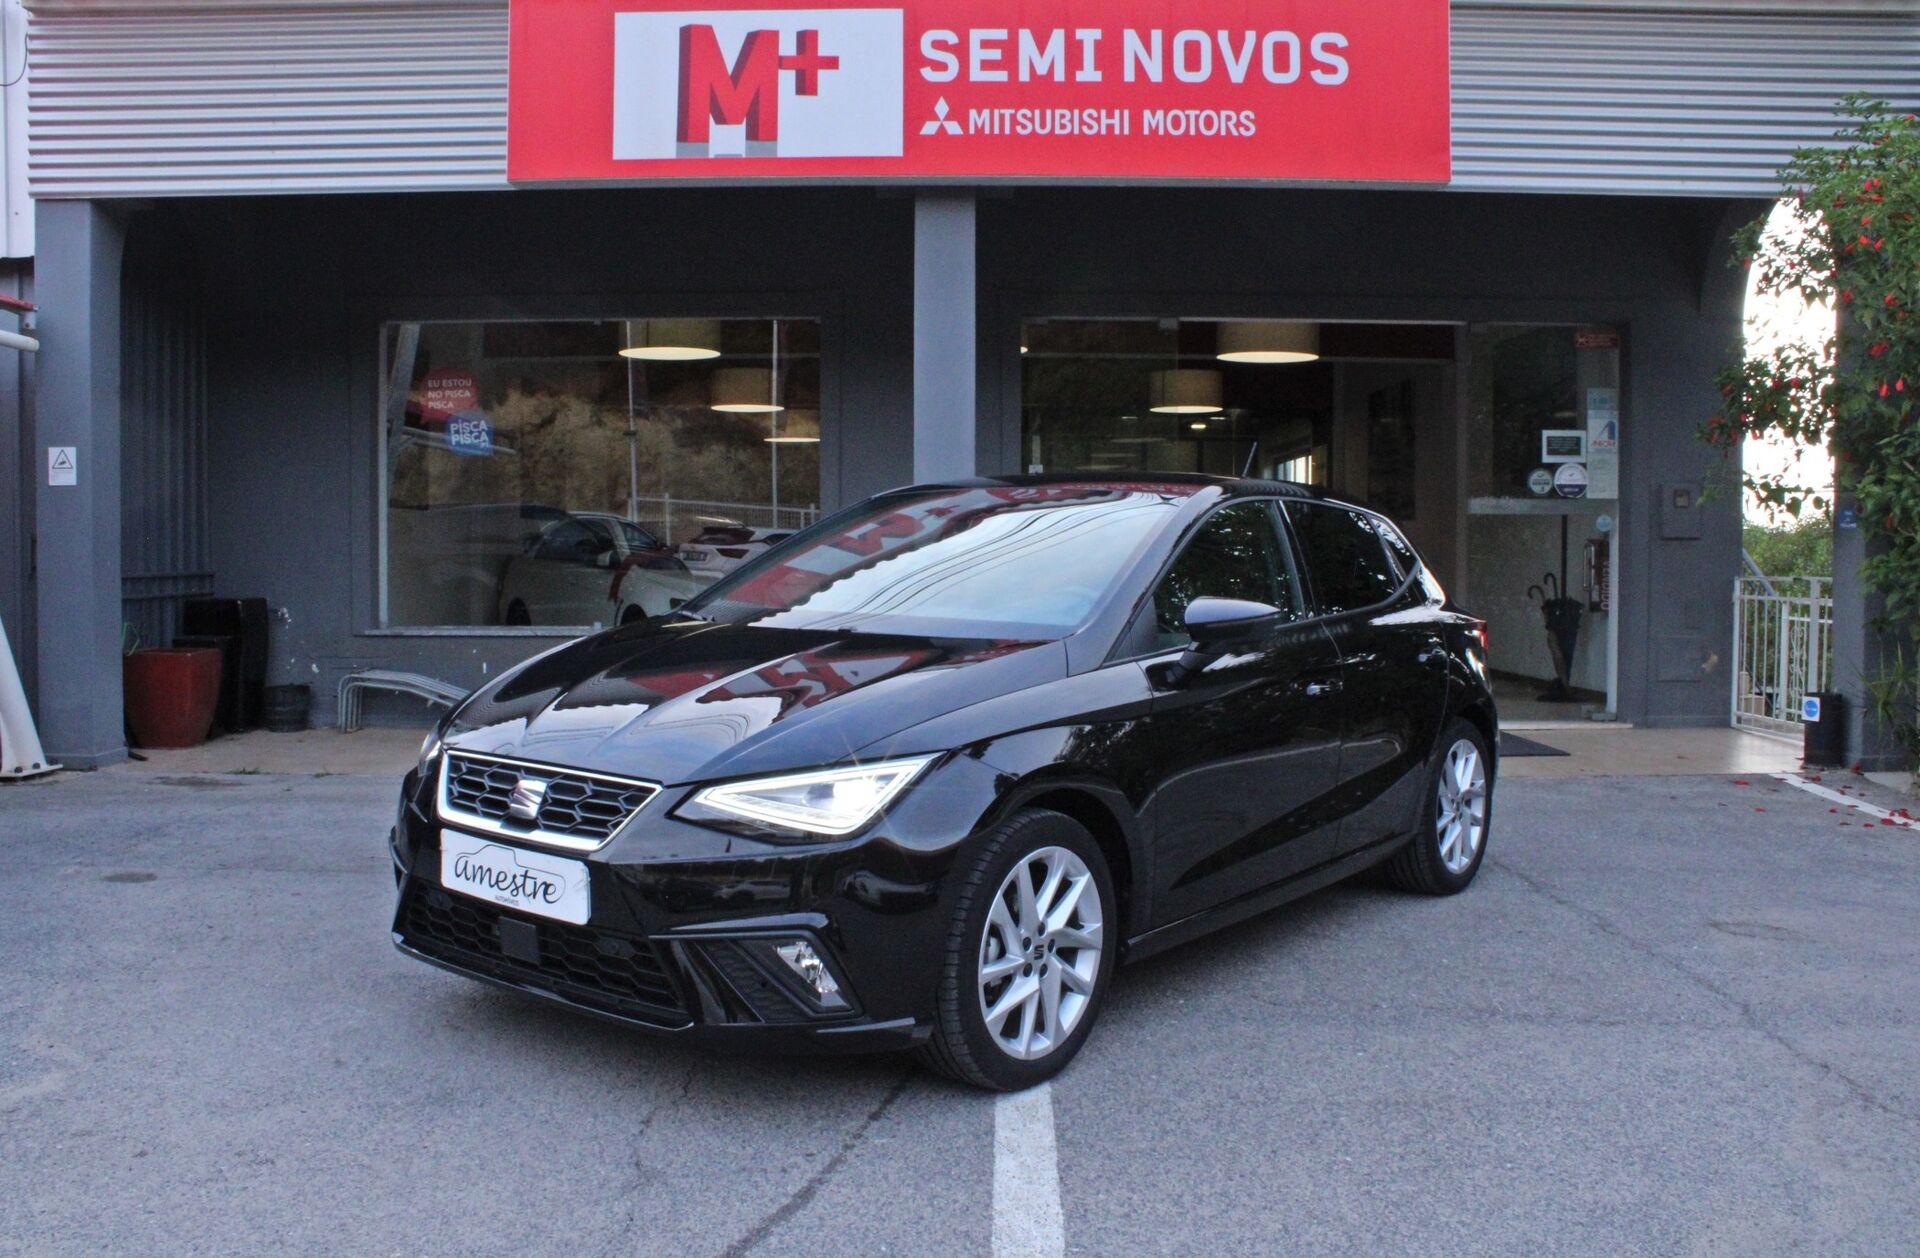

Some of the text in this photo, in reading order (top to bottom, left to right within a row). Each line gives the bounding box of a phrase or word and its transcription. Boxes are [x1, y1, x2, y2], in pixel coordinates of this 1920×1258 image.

[919, 28, 1349, 85] SEMI NOVOS
[968, 108, 1256, 137] MITSUBISHI MOTORS
[428, 379, 472, 388] EU ESTOU
[428, 390, 471, 399] NO PISCA
[428, 401, 454, 409] PISCA
[454, 855, 557, 905] amestre
